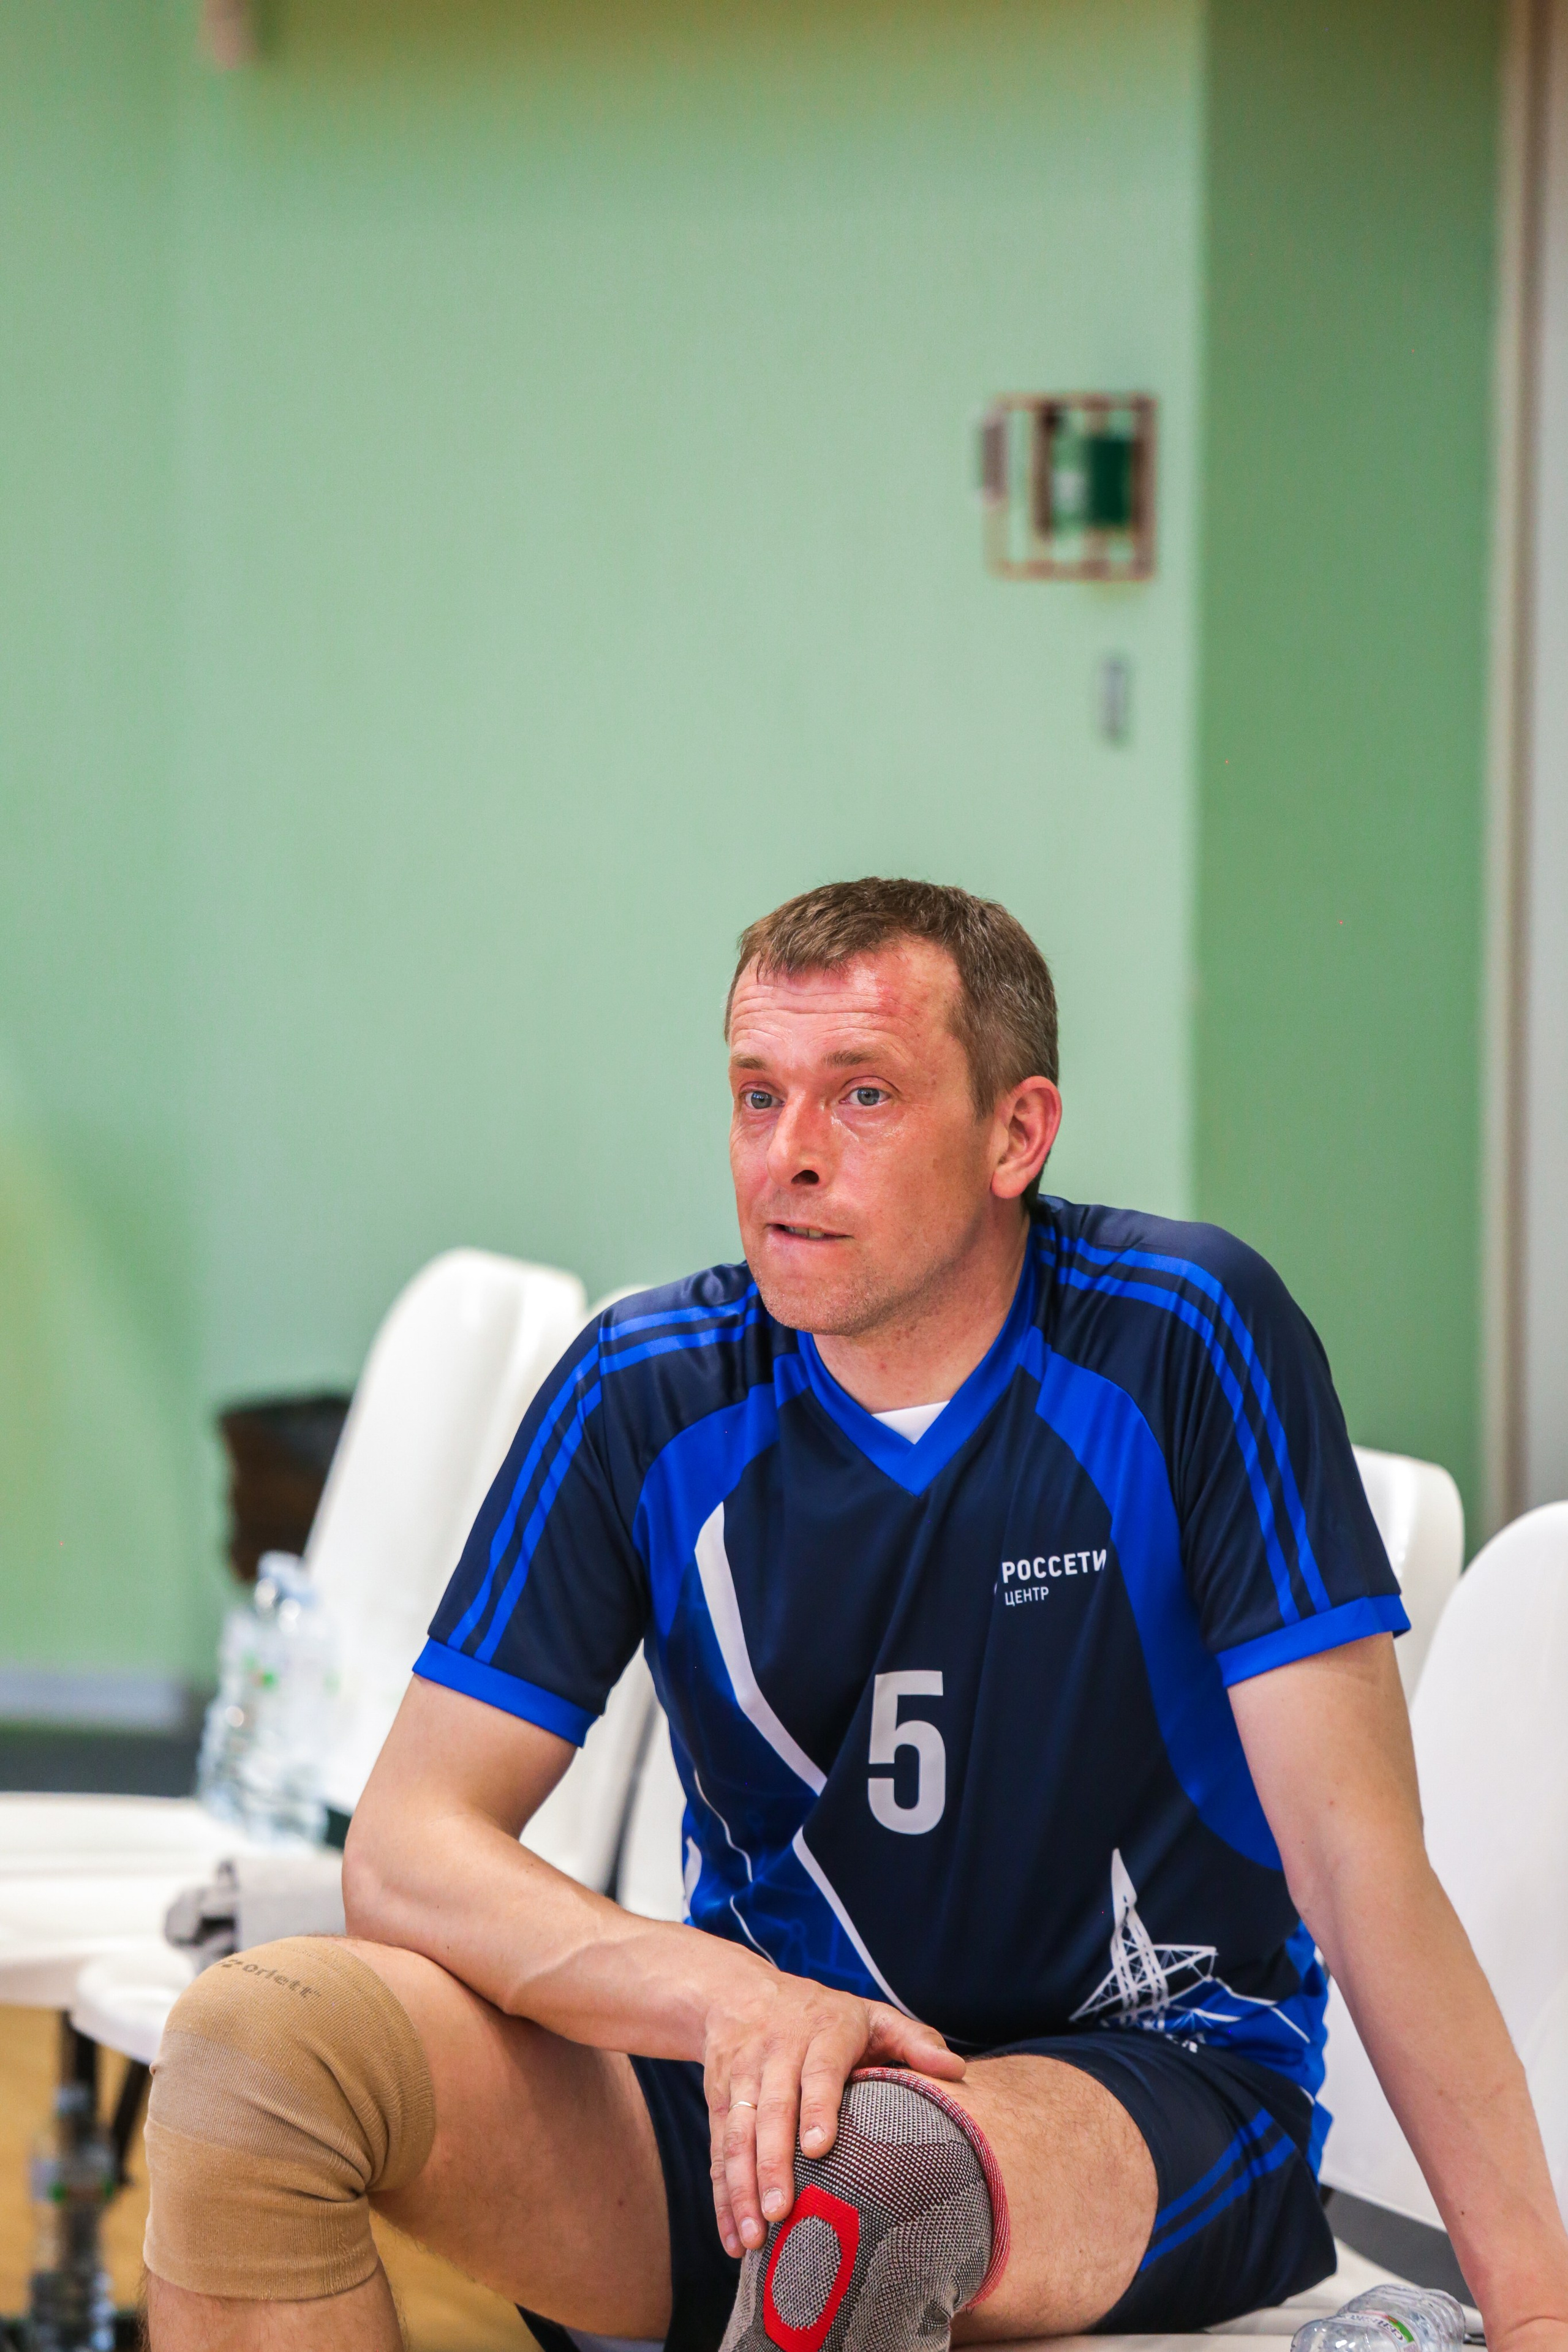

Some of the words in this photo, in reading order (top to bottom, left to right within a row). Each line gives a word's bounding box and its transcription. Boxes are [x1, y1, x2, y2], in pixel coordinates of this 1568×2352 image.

[1001, 1548, 1107, 1584] РОССЕТИ
[1005, 1586, 1049, 1607] ЦЕНТР
[867, 1669, 946, 1835] 5
[243, 1964, 312, 1998] orlett
